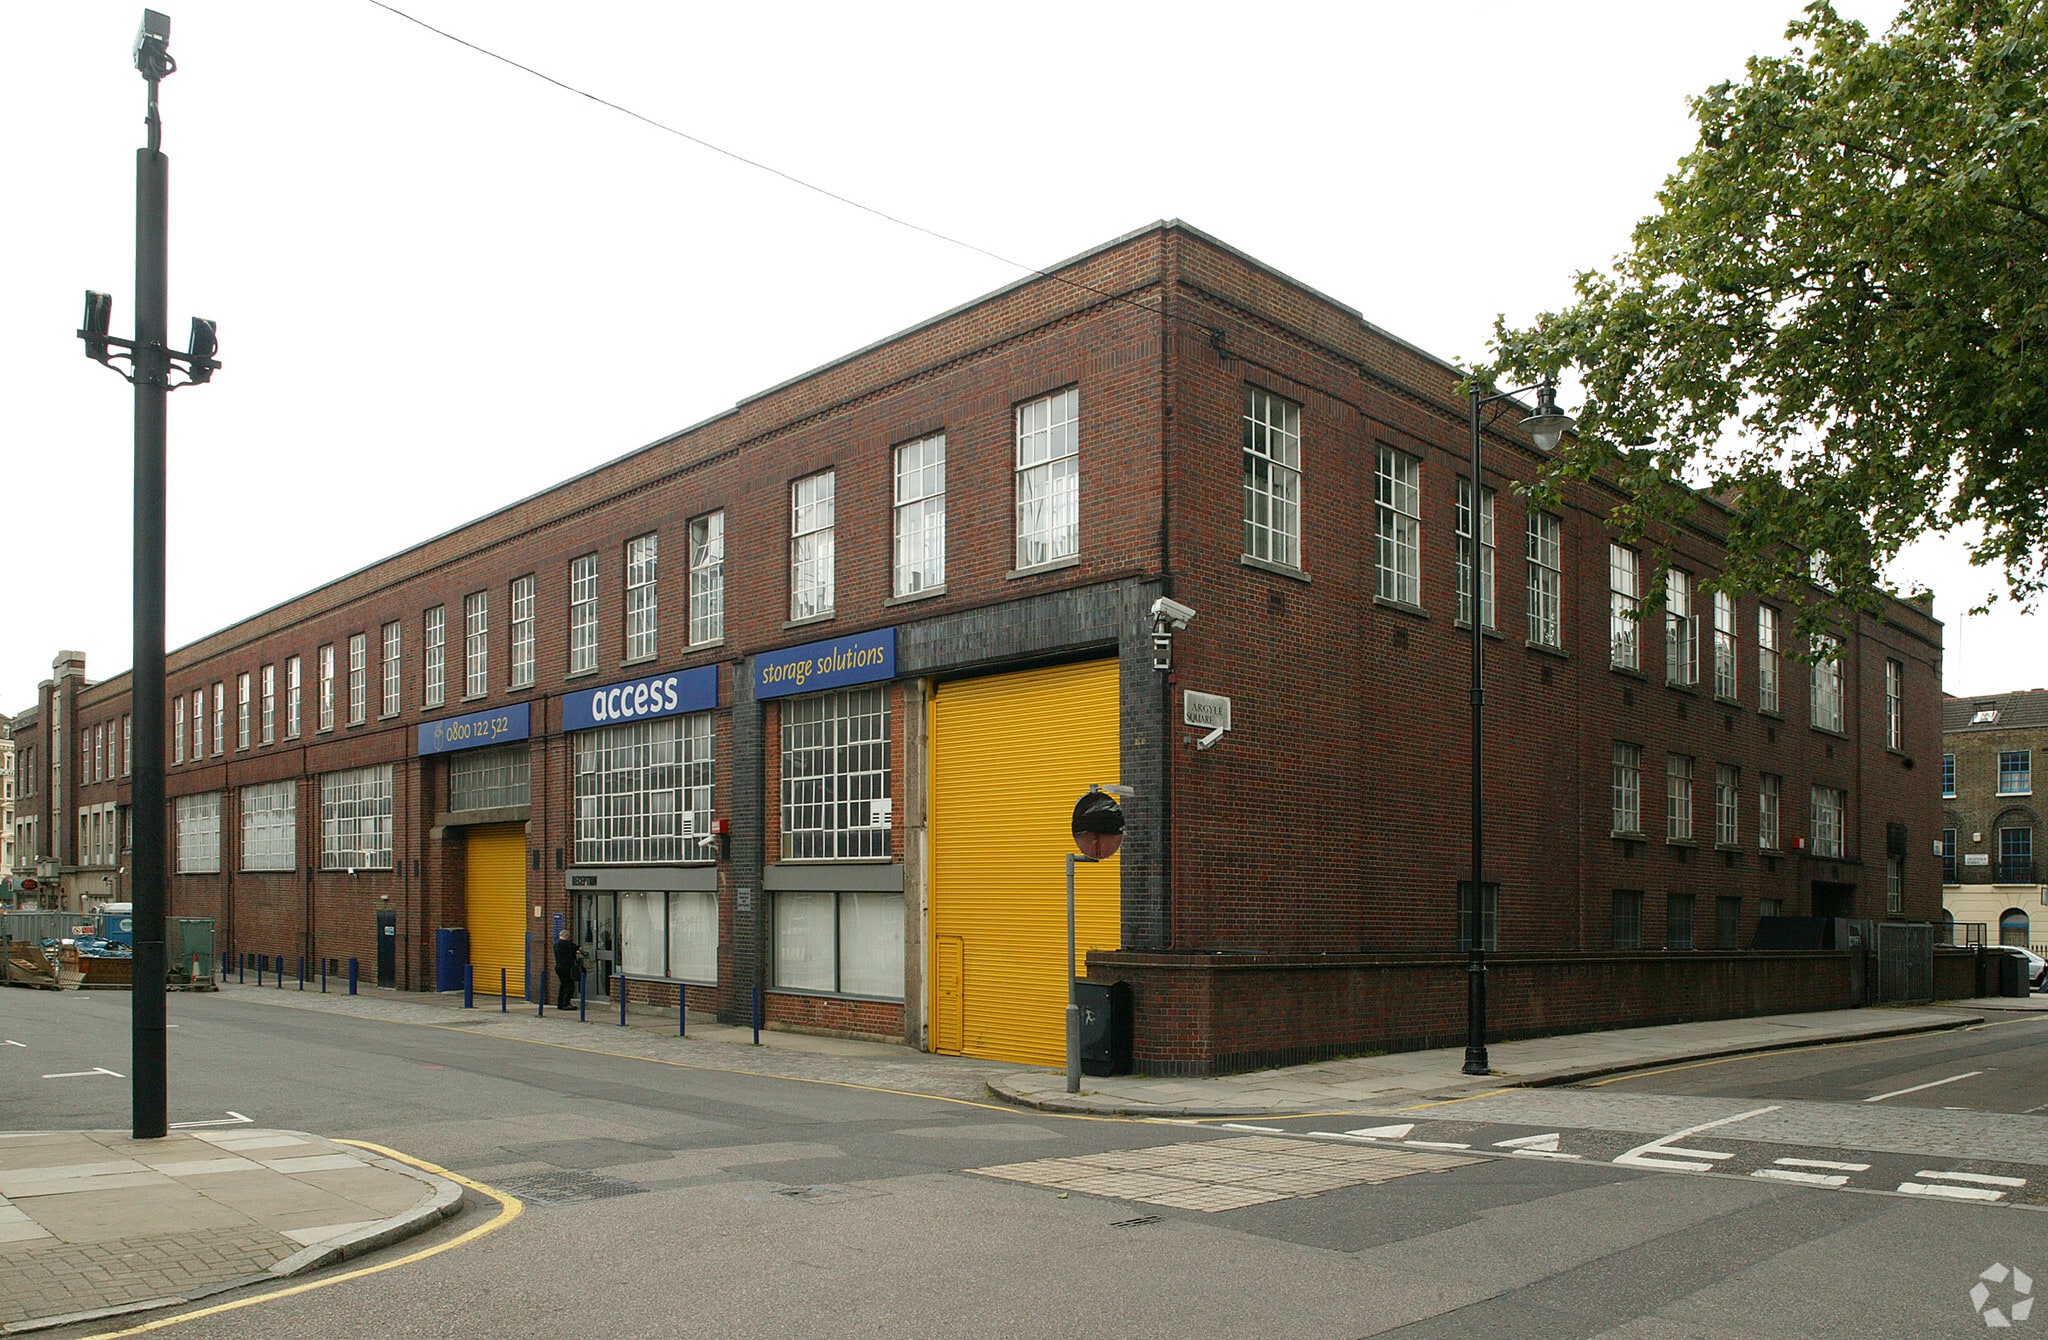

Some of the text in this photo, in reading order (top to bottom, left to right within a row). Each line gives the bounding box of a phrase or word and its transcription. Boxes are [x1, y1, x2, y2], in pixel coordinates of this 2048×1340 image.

[763, 644, 884, 685] storage solutions
[592, 677, 678, 721] access
[1191, 703, 1224, 716] ARGYLE
[446, 716, 509, 742] 0800 122 522
[1186, 712, 1213, 724] SQUARE
